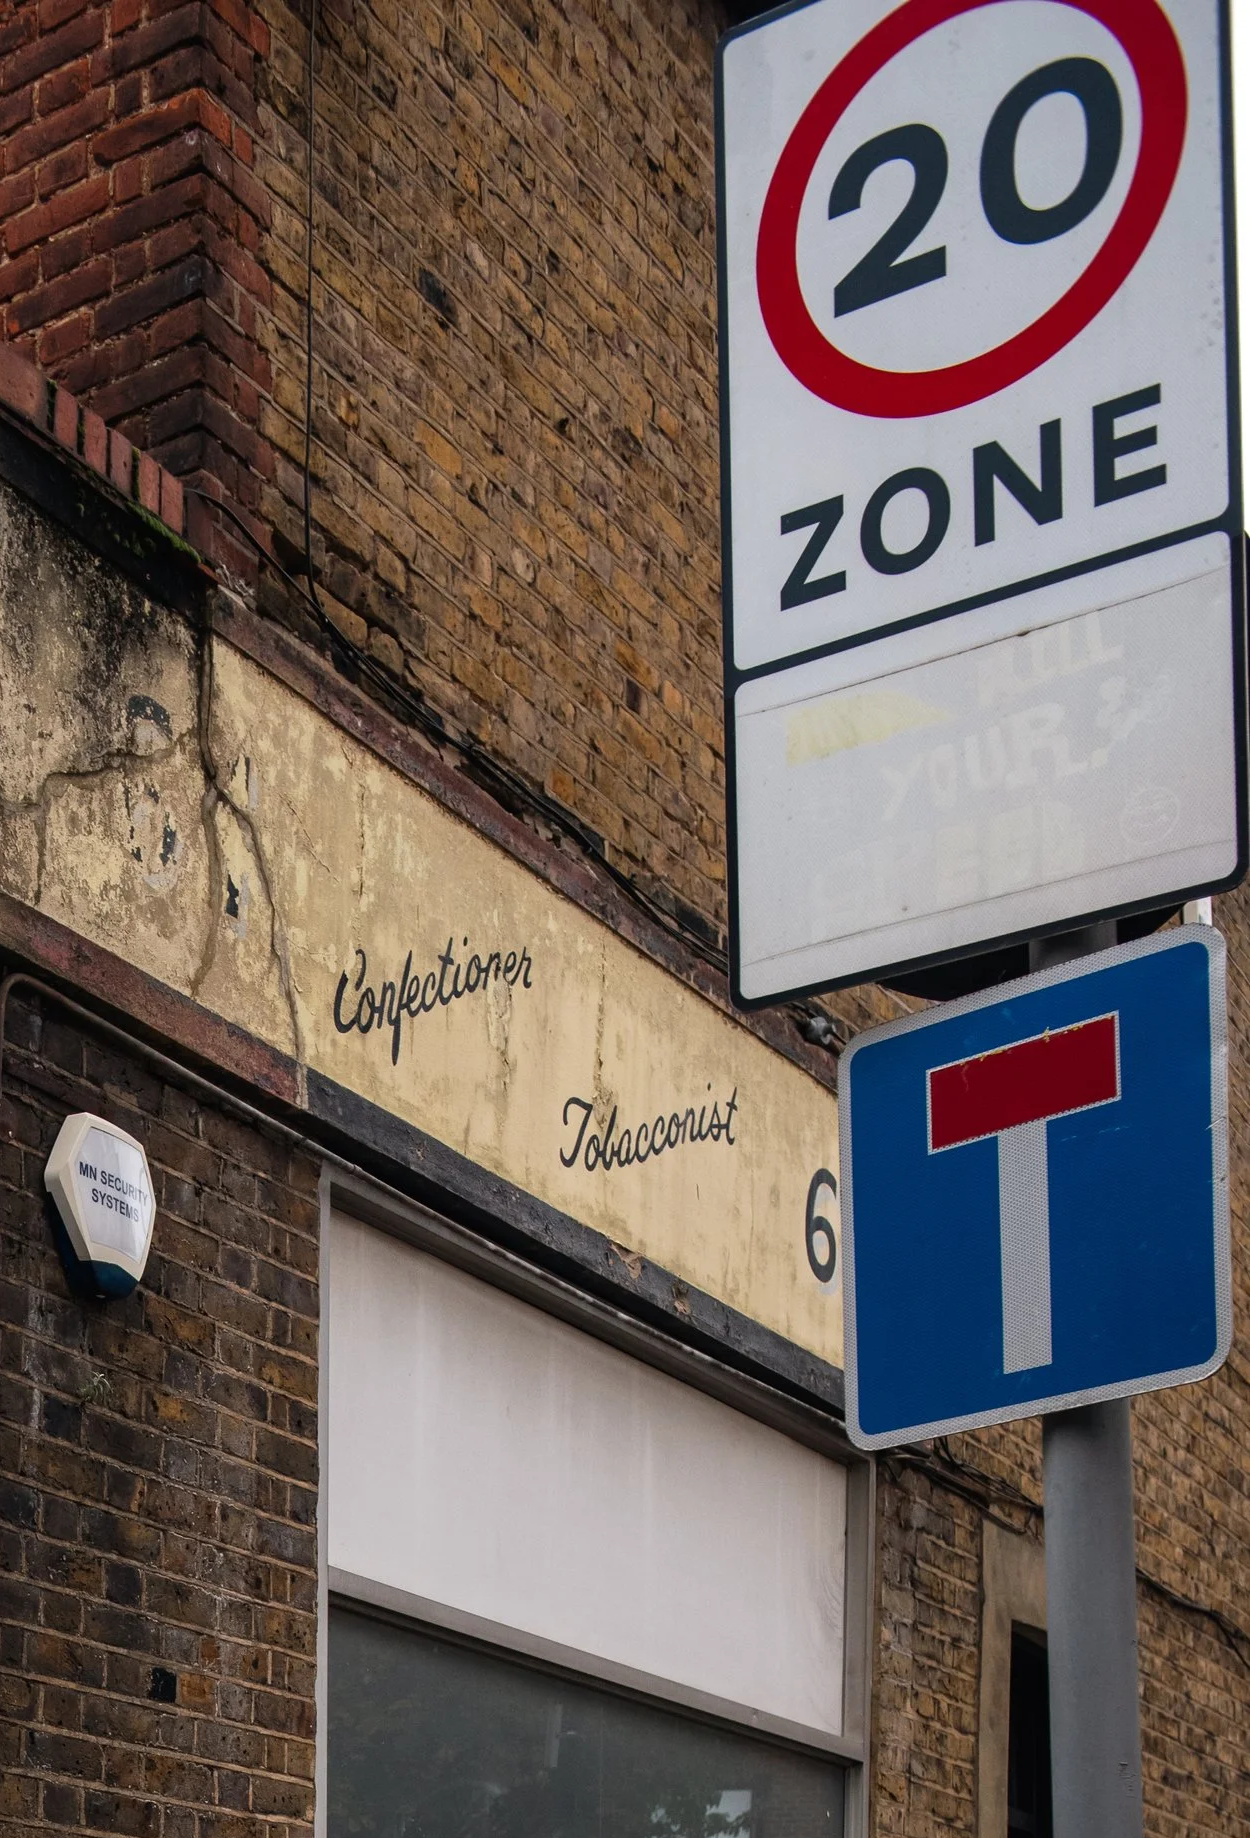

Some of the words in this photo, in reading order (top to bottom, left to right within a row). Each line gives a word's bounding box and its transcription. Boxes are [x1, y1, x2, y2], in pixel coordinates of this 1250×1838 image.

[828, 56, 1123, 318] 20
[780, 383, 1167, 612] ZONE
[332, 937, 533, 1066] Confectioner
[559, 1082, 739, 1172] Tobacconist
[79, 1161, 98, 1181] MN
[100, 1170, 148, 1206] SECURITY
[91, 1188, 139, 1223] SYSTEMS
